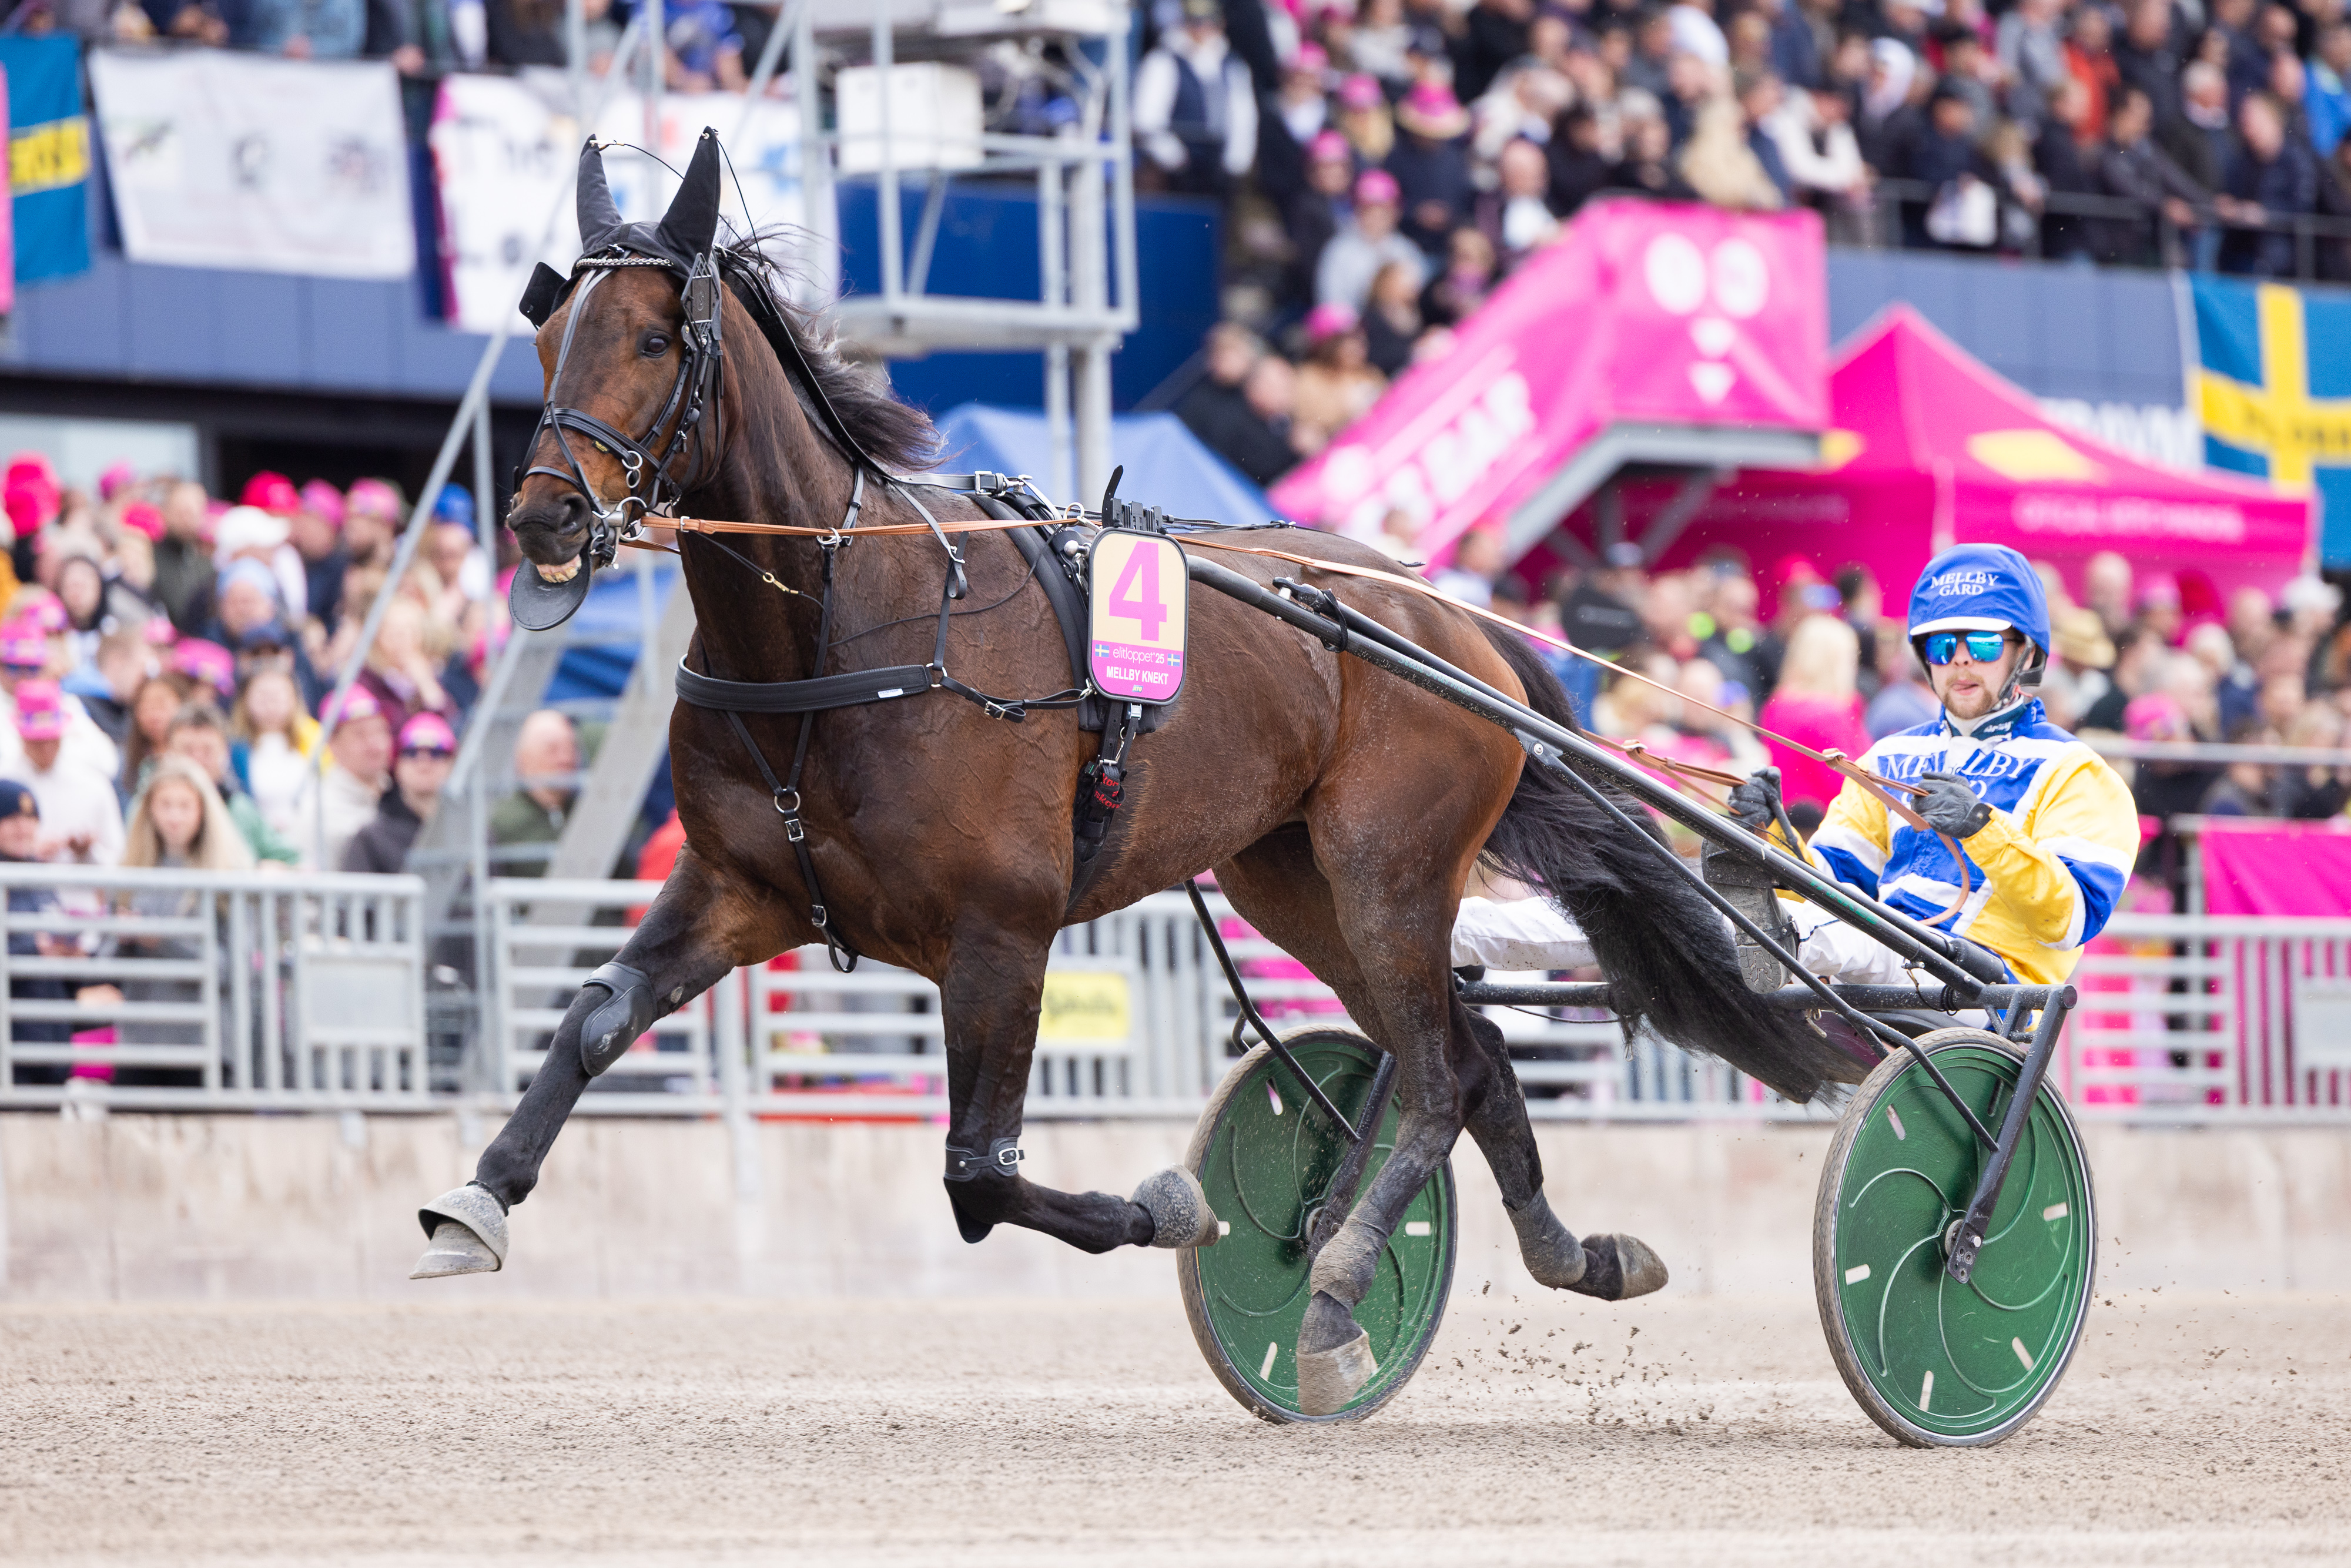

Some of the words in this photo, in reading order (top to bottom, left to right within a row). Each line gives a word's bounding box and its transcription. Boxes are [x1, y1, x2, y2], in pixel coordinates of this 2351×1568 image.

[1109, 541, 1167, 642] 4
[1930, 571, 1999, 589] MELLBY
[1107, 666, 1140, 682] MELLBY
[1142, 670, 1169, 685] KNEKT
[1810, 879, 1879, 925] YANKEE
